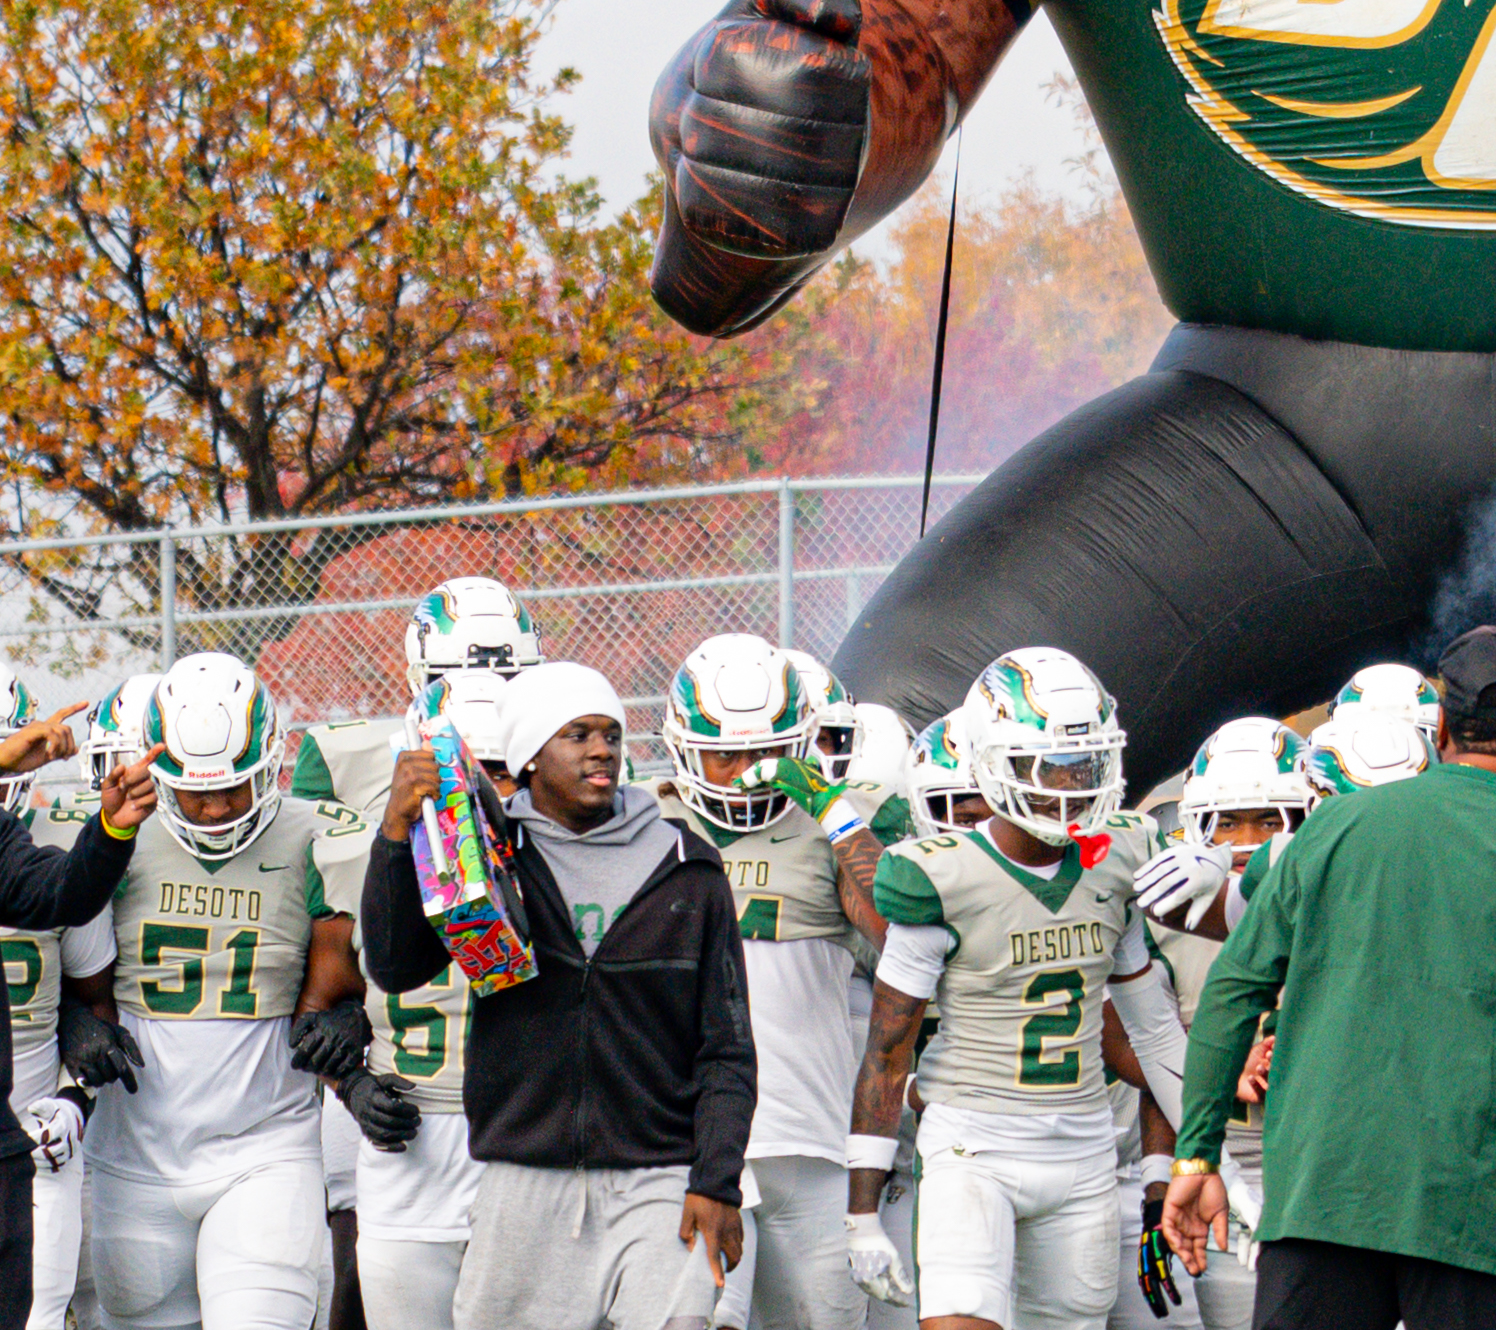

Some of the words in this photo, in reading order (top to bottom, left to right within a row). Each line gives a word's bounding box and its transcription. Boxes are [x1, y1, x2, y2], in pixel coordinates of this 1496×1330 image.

[912, 833, 962, 858] 2
[158, 881, 262, 922] DESOTO
[1009, 920, 1104, 968] DESOTO
[138, 919, 262, 1019] 51
[1014, 966, 1087, 1090] 2
